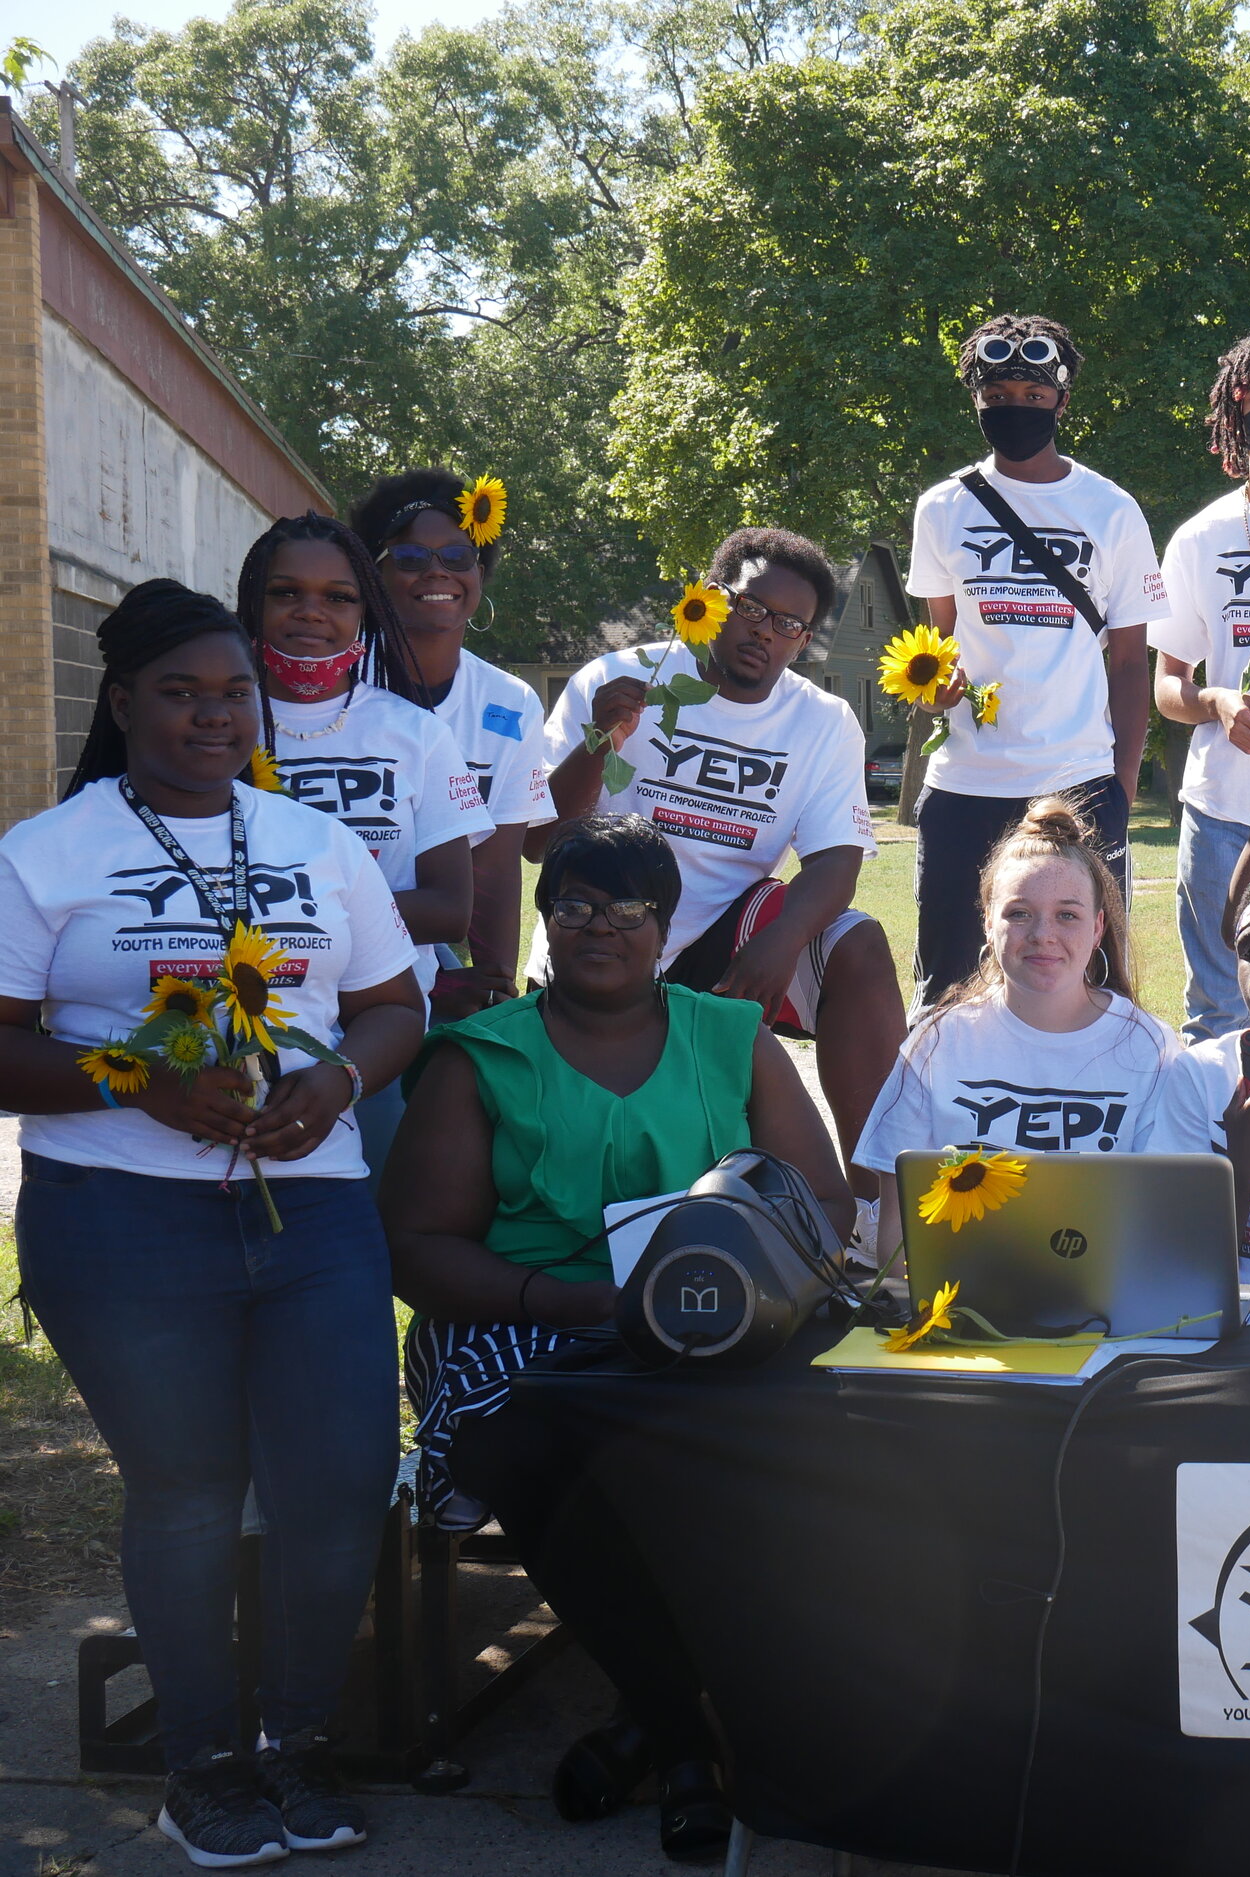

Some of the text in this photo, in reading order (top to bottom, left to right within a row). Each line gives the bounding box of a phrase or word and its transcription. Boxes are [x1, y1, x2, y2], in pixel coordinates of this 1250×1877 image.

[1144, 572, 1161, 583] Free
[990, 586, 1055, 597] EMPOWERMENT
[1143, 581, 1164, 594] Liber
[983, 603, 1074, 614] every vote matters.
[985, 613, 1070, 624] every vote counts.
[649, 737, 788, 800] YEP!
[449, 773, 474, 787] Freed
[280, 767, 397, 813] EP!
[449, 786, 480, 800] Libera
[460, 797, 486, 810] Justic
[636, 786, 777, 824] YOUTH EMPOWERMENT PROJECT
[138, 805, 178, 848] 2020 GRAD
[657, 810, 754, 837] every vote matters.
[657, 820, 748, 846] every vote counts.
[187, 869, 225, 914] 2020 GRAD
[235, 886, 247, 910] GRAD
[112, 937, 163, 951] YOUTH
[279, 937, 332, 951] PROJECT
[156, 962, 201, 976] every
[952, 1096, 1127, 1152] YEP!
